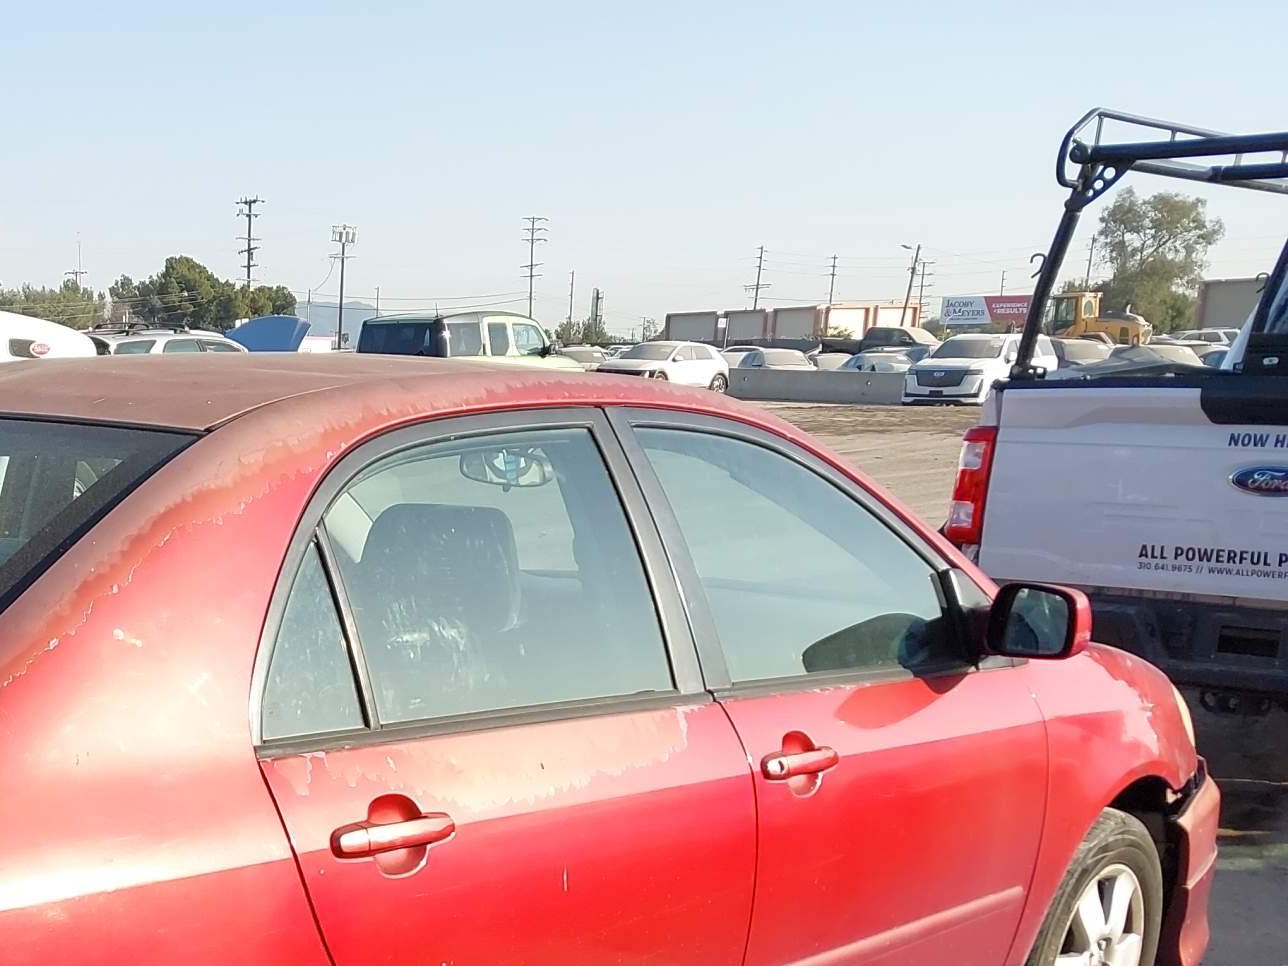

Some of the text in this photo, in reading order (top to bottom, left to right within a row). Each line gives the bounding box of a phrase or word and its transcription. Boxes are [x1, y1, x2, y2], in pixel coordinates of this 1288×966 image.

[1228, 433, 1288, 448] NOW H
[1138, 544, 1167, 560] ALL
[1174, 547, 1271, 567] POWERFUL
